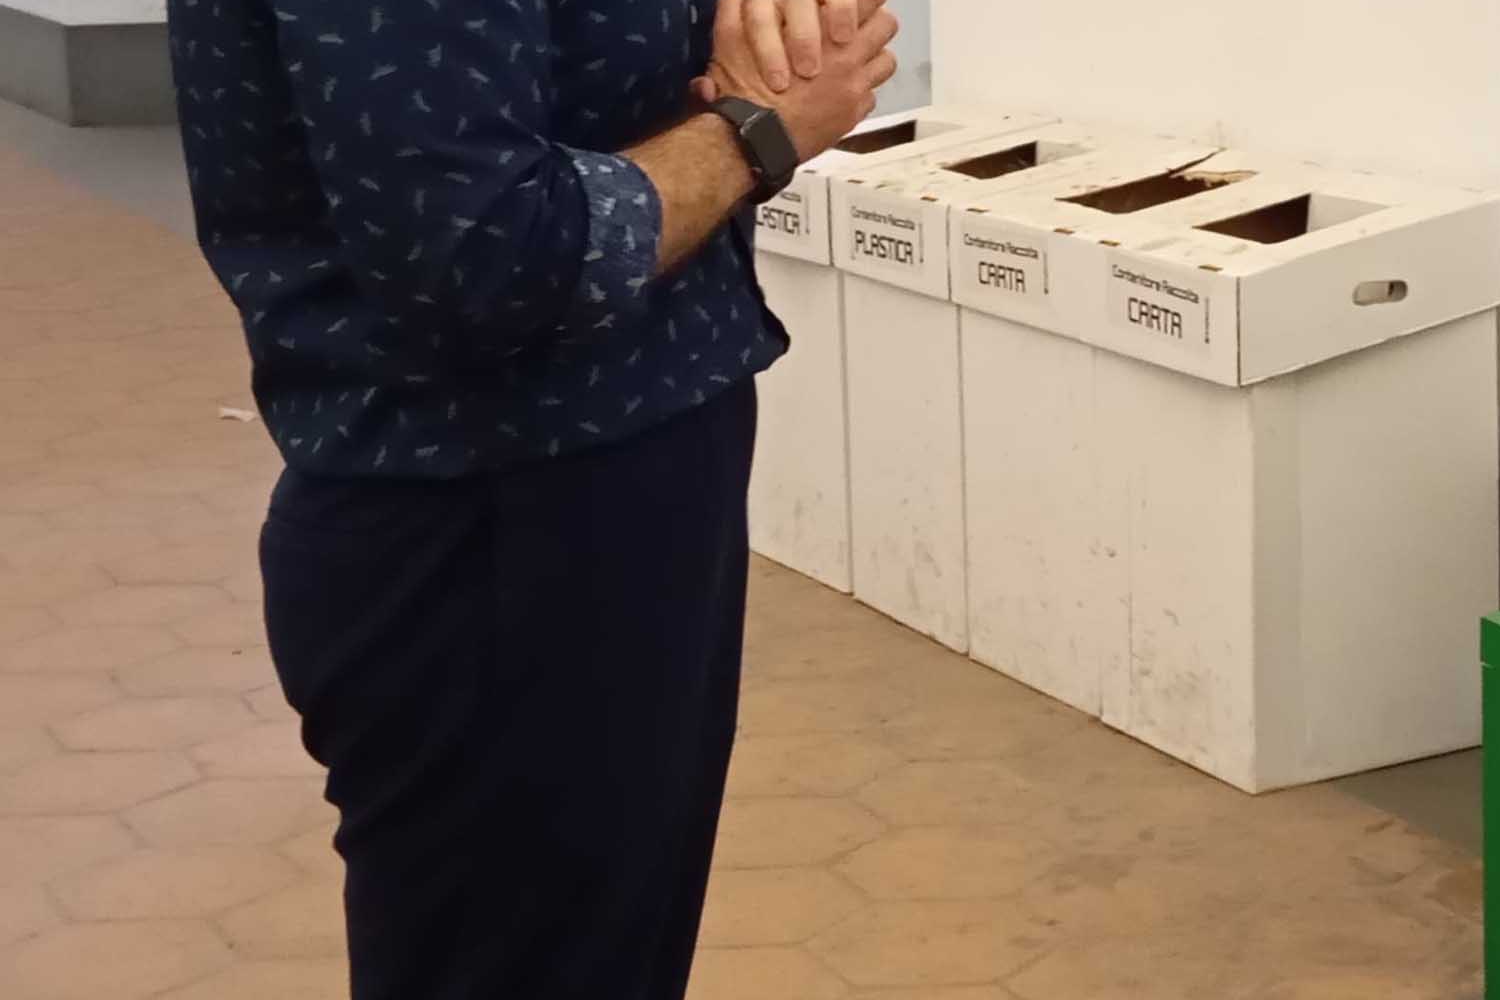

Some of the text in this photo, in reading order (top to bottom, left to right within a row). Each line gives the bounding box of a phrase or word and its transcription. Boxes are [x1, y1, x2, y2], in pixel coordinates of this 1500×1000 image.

[855, 229, 914, 265] PLASTICA
[978, 260, 1027, 294] CARTA
[1128, 296, 1183, 340] CARTA
